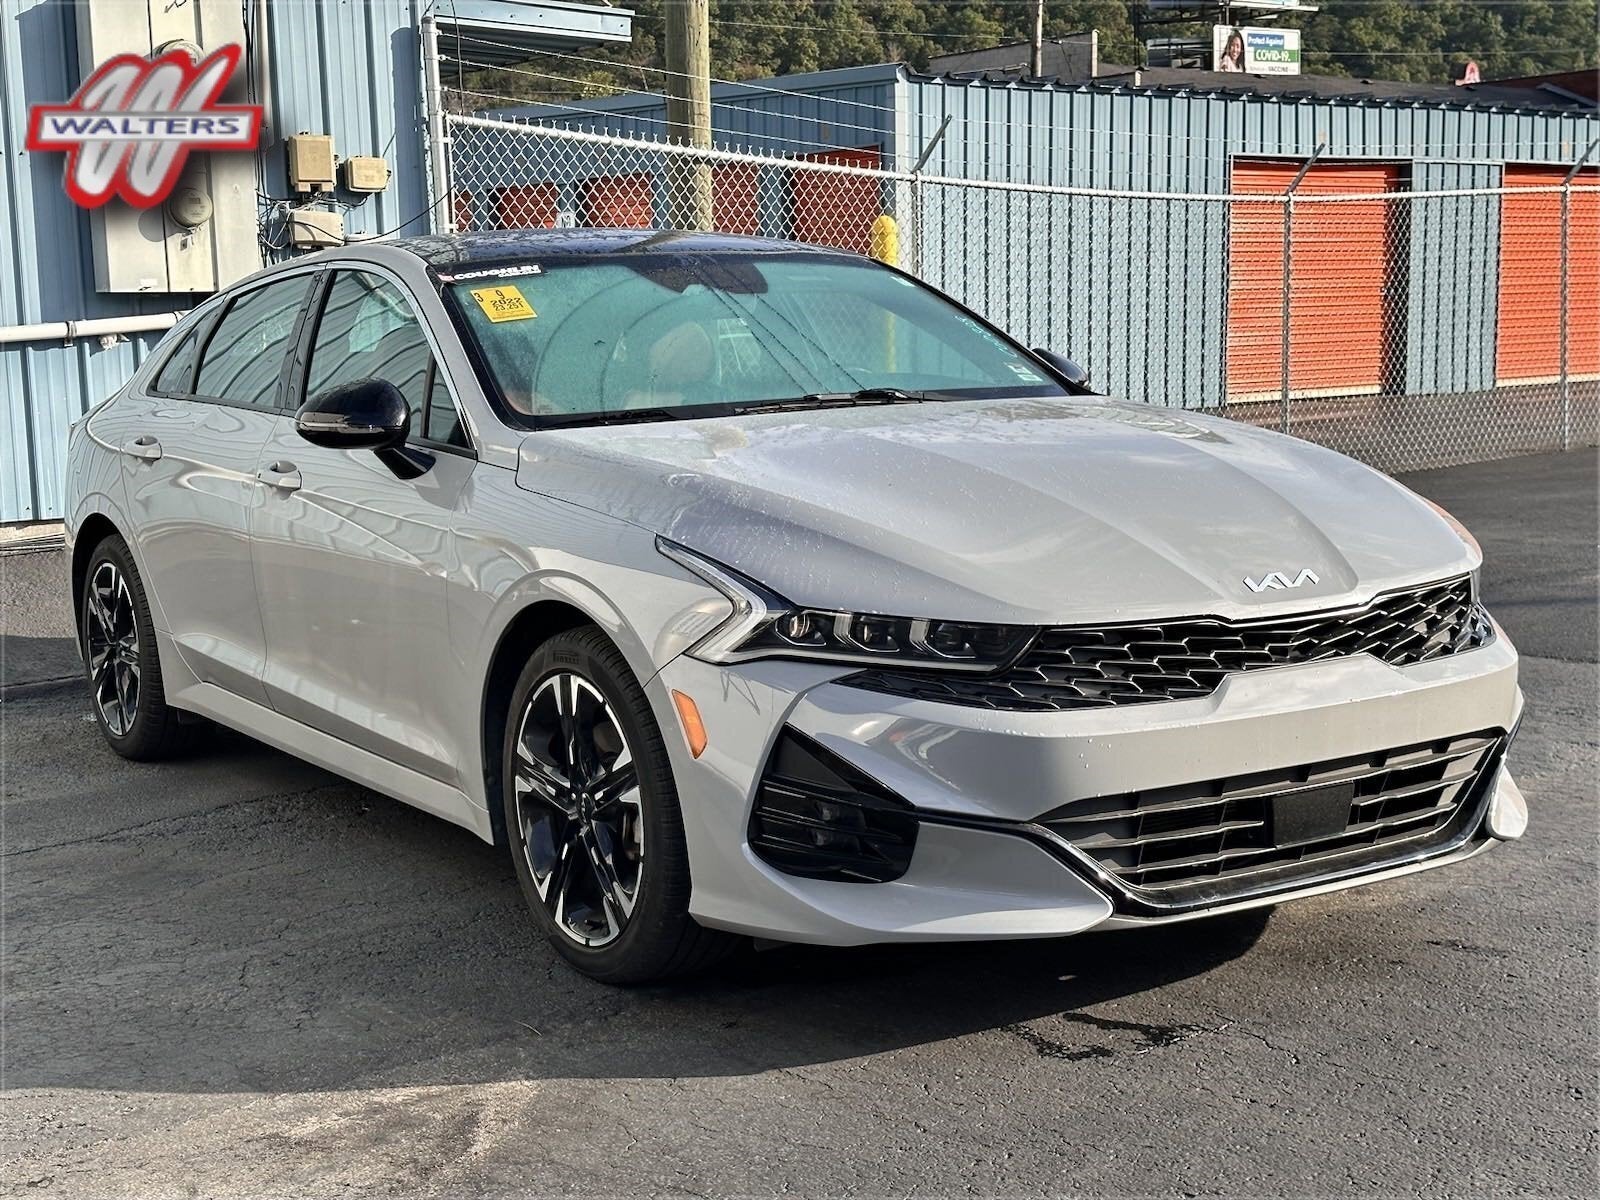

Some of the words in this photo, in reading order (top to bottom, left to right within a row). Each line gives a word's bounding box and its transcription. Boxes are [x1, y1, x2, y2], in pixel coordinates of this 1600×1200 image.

[454, 265, 539, 280] COUGHLIN
[474, 292, 484, 302] 3
[495, 290, 505, 300] 9
[490, 297, 521, 306] 2022
[1243, 568, 1320, 592] KIA
